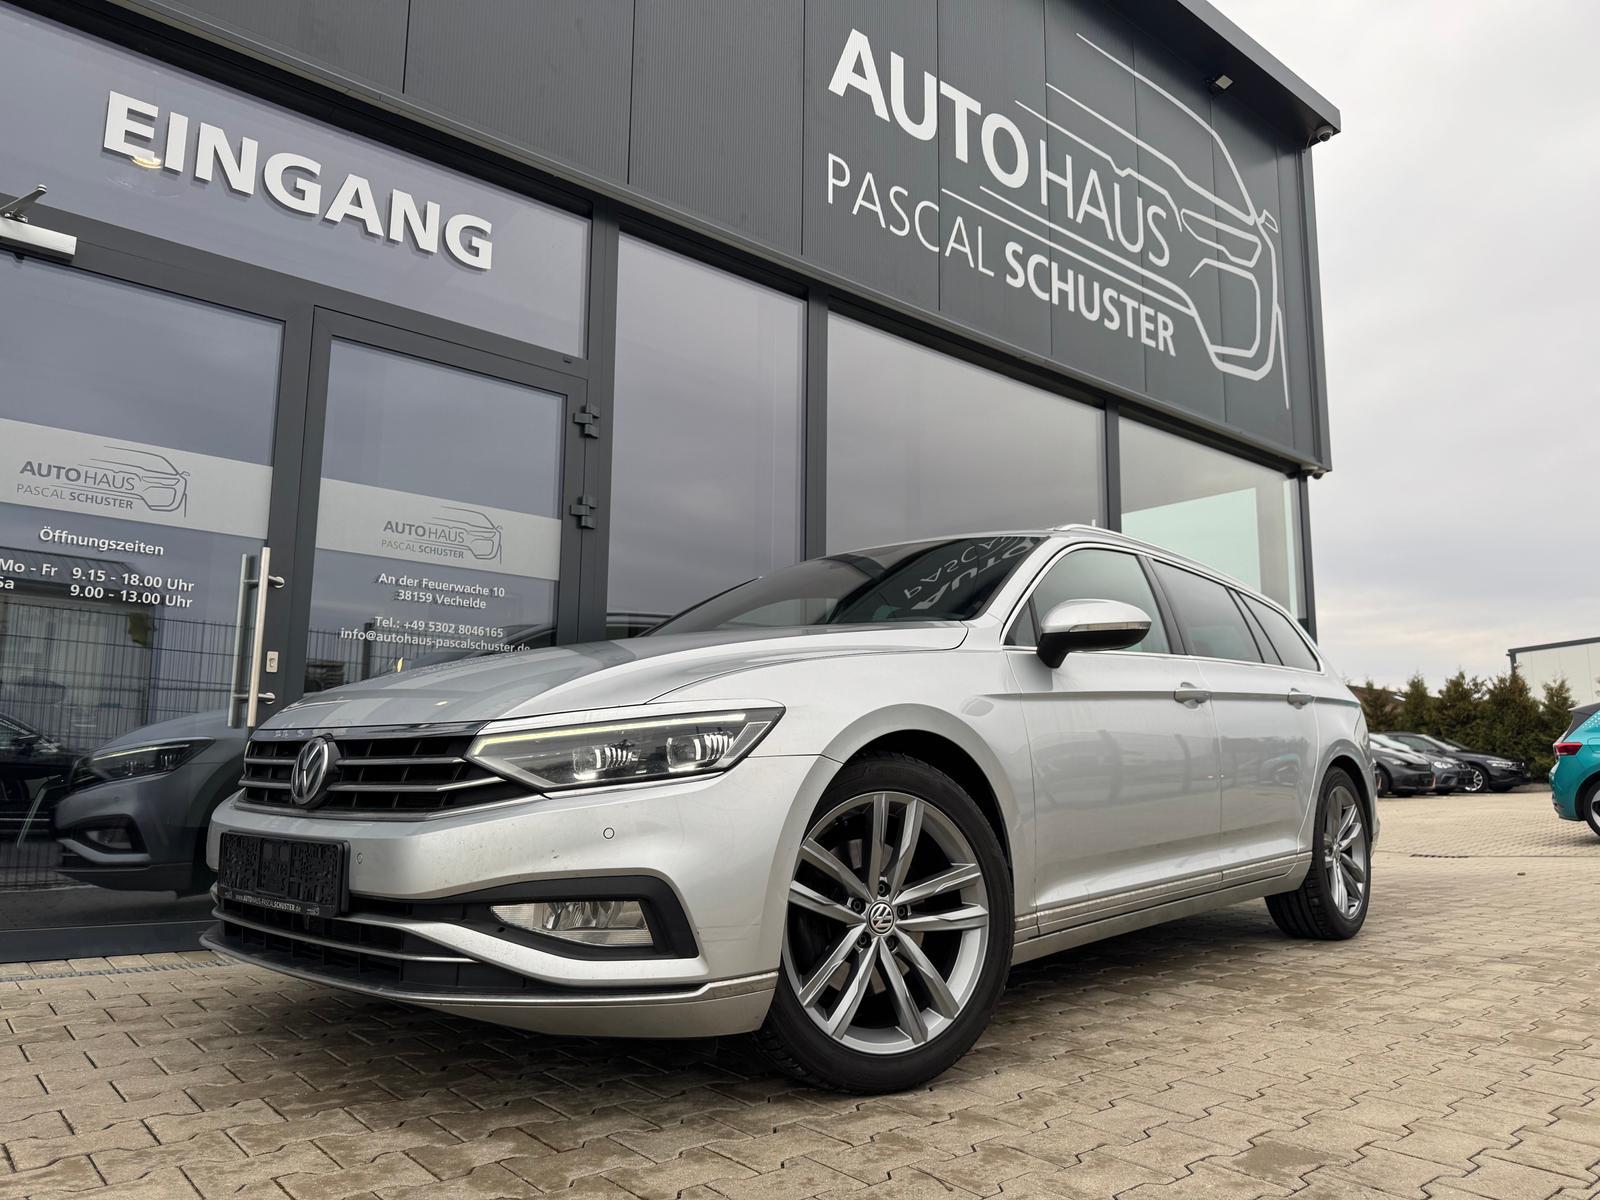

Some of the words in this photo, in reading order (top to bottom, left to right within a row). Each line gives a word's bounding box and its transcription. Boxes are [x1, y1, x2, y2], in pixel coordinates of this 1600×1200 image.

[828, 28, 1170, 267] AUTOHAUS
[103, 90, 493, 271] EINGANG
[828, 152, 995, 277] PASCAL
[1005, 241, 1176, 357] SCHUSTER
[19, 461, 136, 492] AUTOHAUS
[16, 483, 66, 501] PASCAL
[69, 491, 134, 510] SCHUSTER
[39, 526, 164, 556] Öffnungszeiten
[383, 520, 465, 544] AUTOHAUS
[381, 539, 416, 553] PASCAL
[418, 544, 465, 559] SCHUSTER
[0, 558, 25, 572] Mo
[42, 563, 58, 577] Fr
[72, 567, 106, 582] 9.15
[122, 573, 162, 588] 18.00
[167, 578, 195, 592] Uhr
[378, 573, 396, 584] An
[399, 576, 419, 587] der
[422, 578, 489, 596] Feuerwache
[493, 587, 505, 597] 10
[70, 584, 104, 599] 9.00
[120, 590, 160, 605] 13.00
[165, 594, 193, 608] Uhr
[398, 589, 433, 603] 38159
[436, 594, 487, 609] Vechelde
[375, 616, 400, 629] Tel.:
[403, 619, 425, 631] +49
[429, 622, 455, 634] 5302
[458, 625, 504, 638] 8046165
